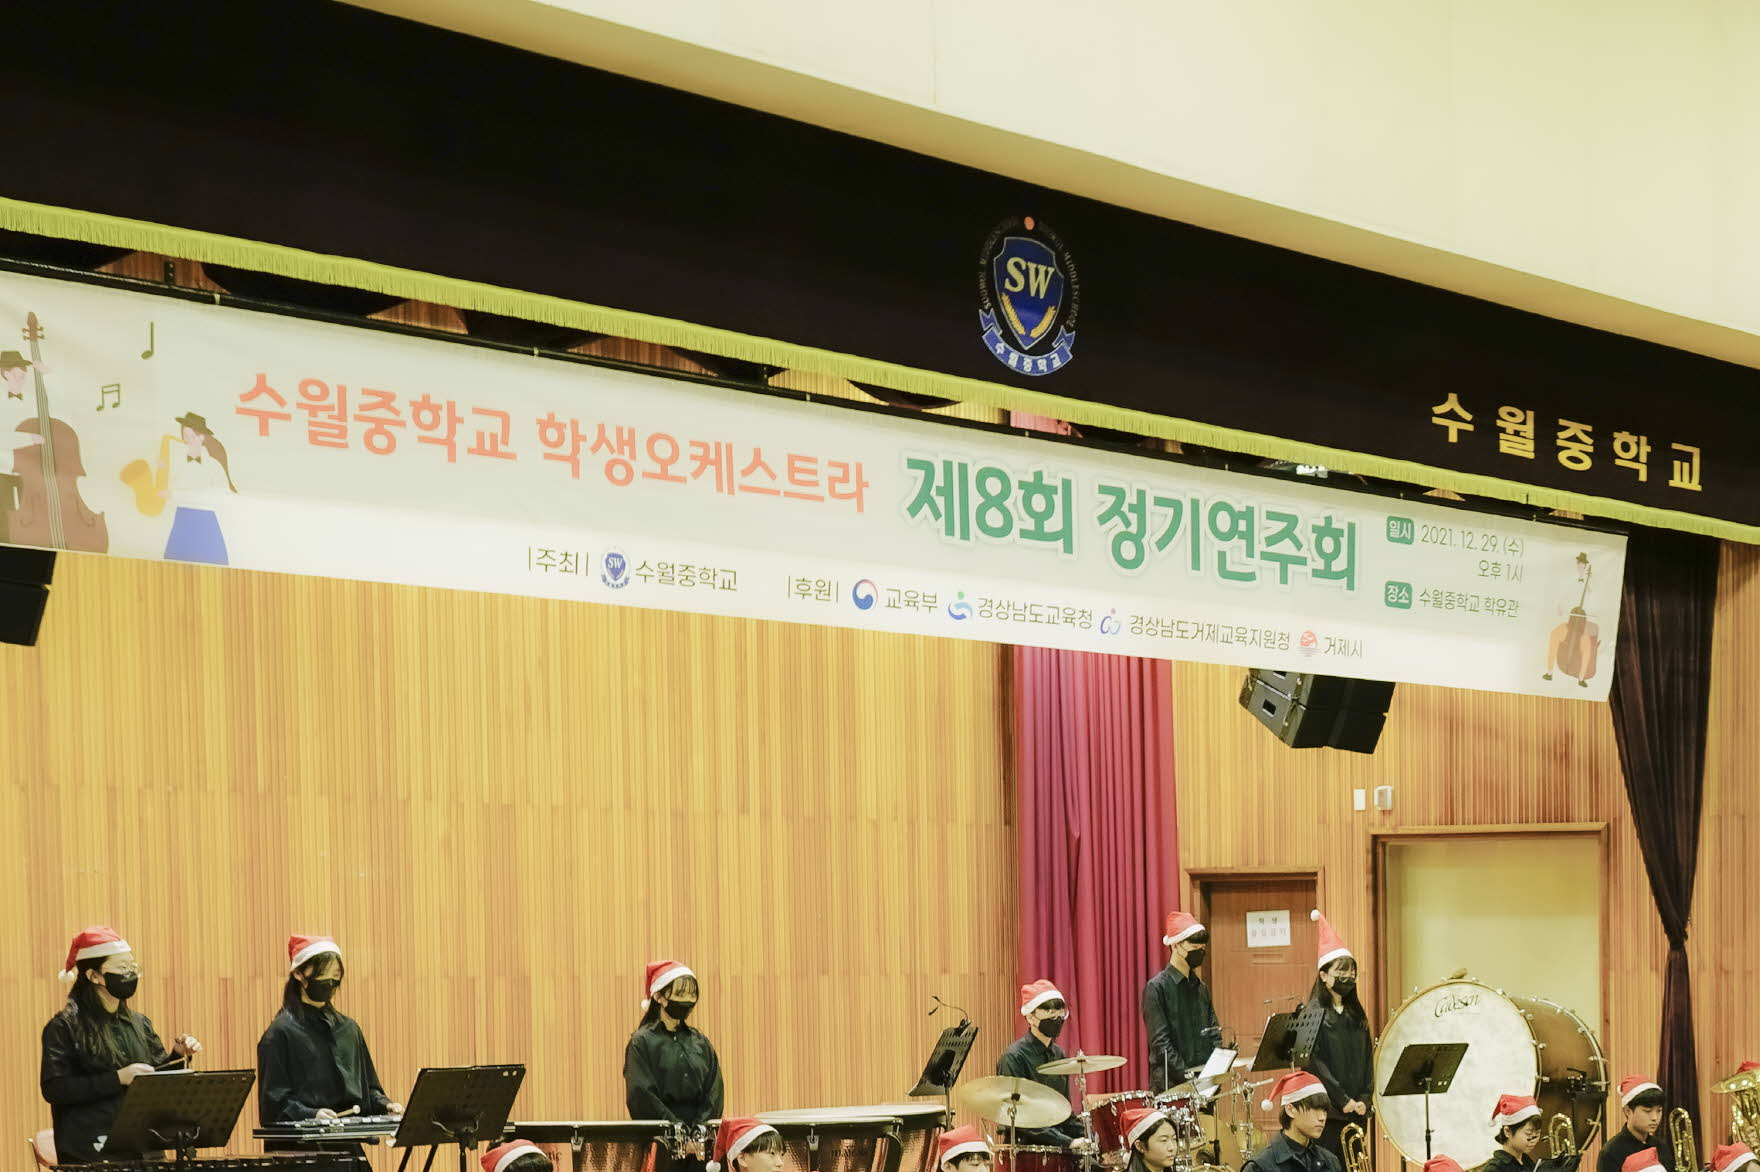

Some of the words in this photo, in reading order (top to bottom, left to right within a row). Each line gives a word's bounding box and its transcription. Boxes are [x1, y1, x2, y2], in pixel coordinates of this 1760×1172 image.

[1004, 257, 1055, 300] SW
[235, 373, 517, 463] 수월중학교
[535, 412, 869, 513] 학생오케스트라
[906, 457, 1074, 555] 제8회
[1096, 484, 1356, 591] 정기연주회
[1389, 520, 1411, 540] 일시
[1478, 560, 1502, 580] 오후
[1506, 563, 1524, 583] 1시
[635, 560, 738, 592] 수월중학교
[884, 587, 938, 614] 교육부
[977, 598, 1093, 630] 경상남도교육청
[1129, 615, 1291, 651] 경상남도거제교육지원청
[1324, 636, 1363, 659] 거제시
[1387, 585, 1409, 604] 장소
[1419, 588, 1480, 613] 수월중학교
